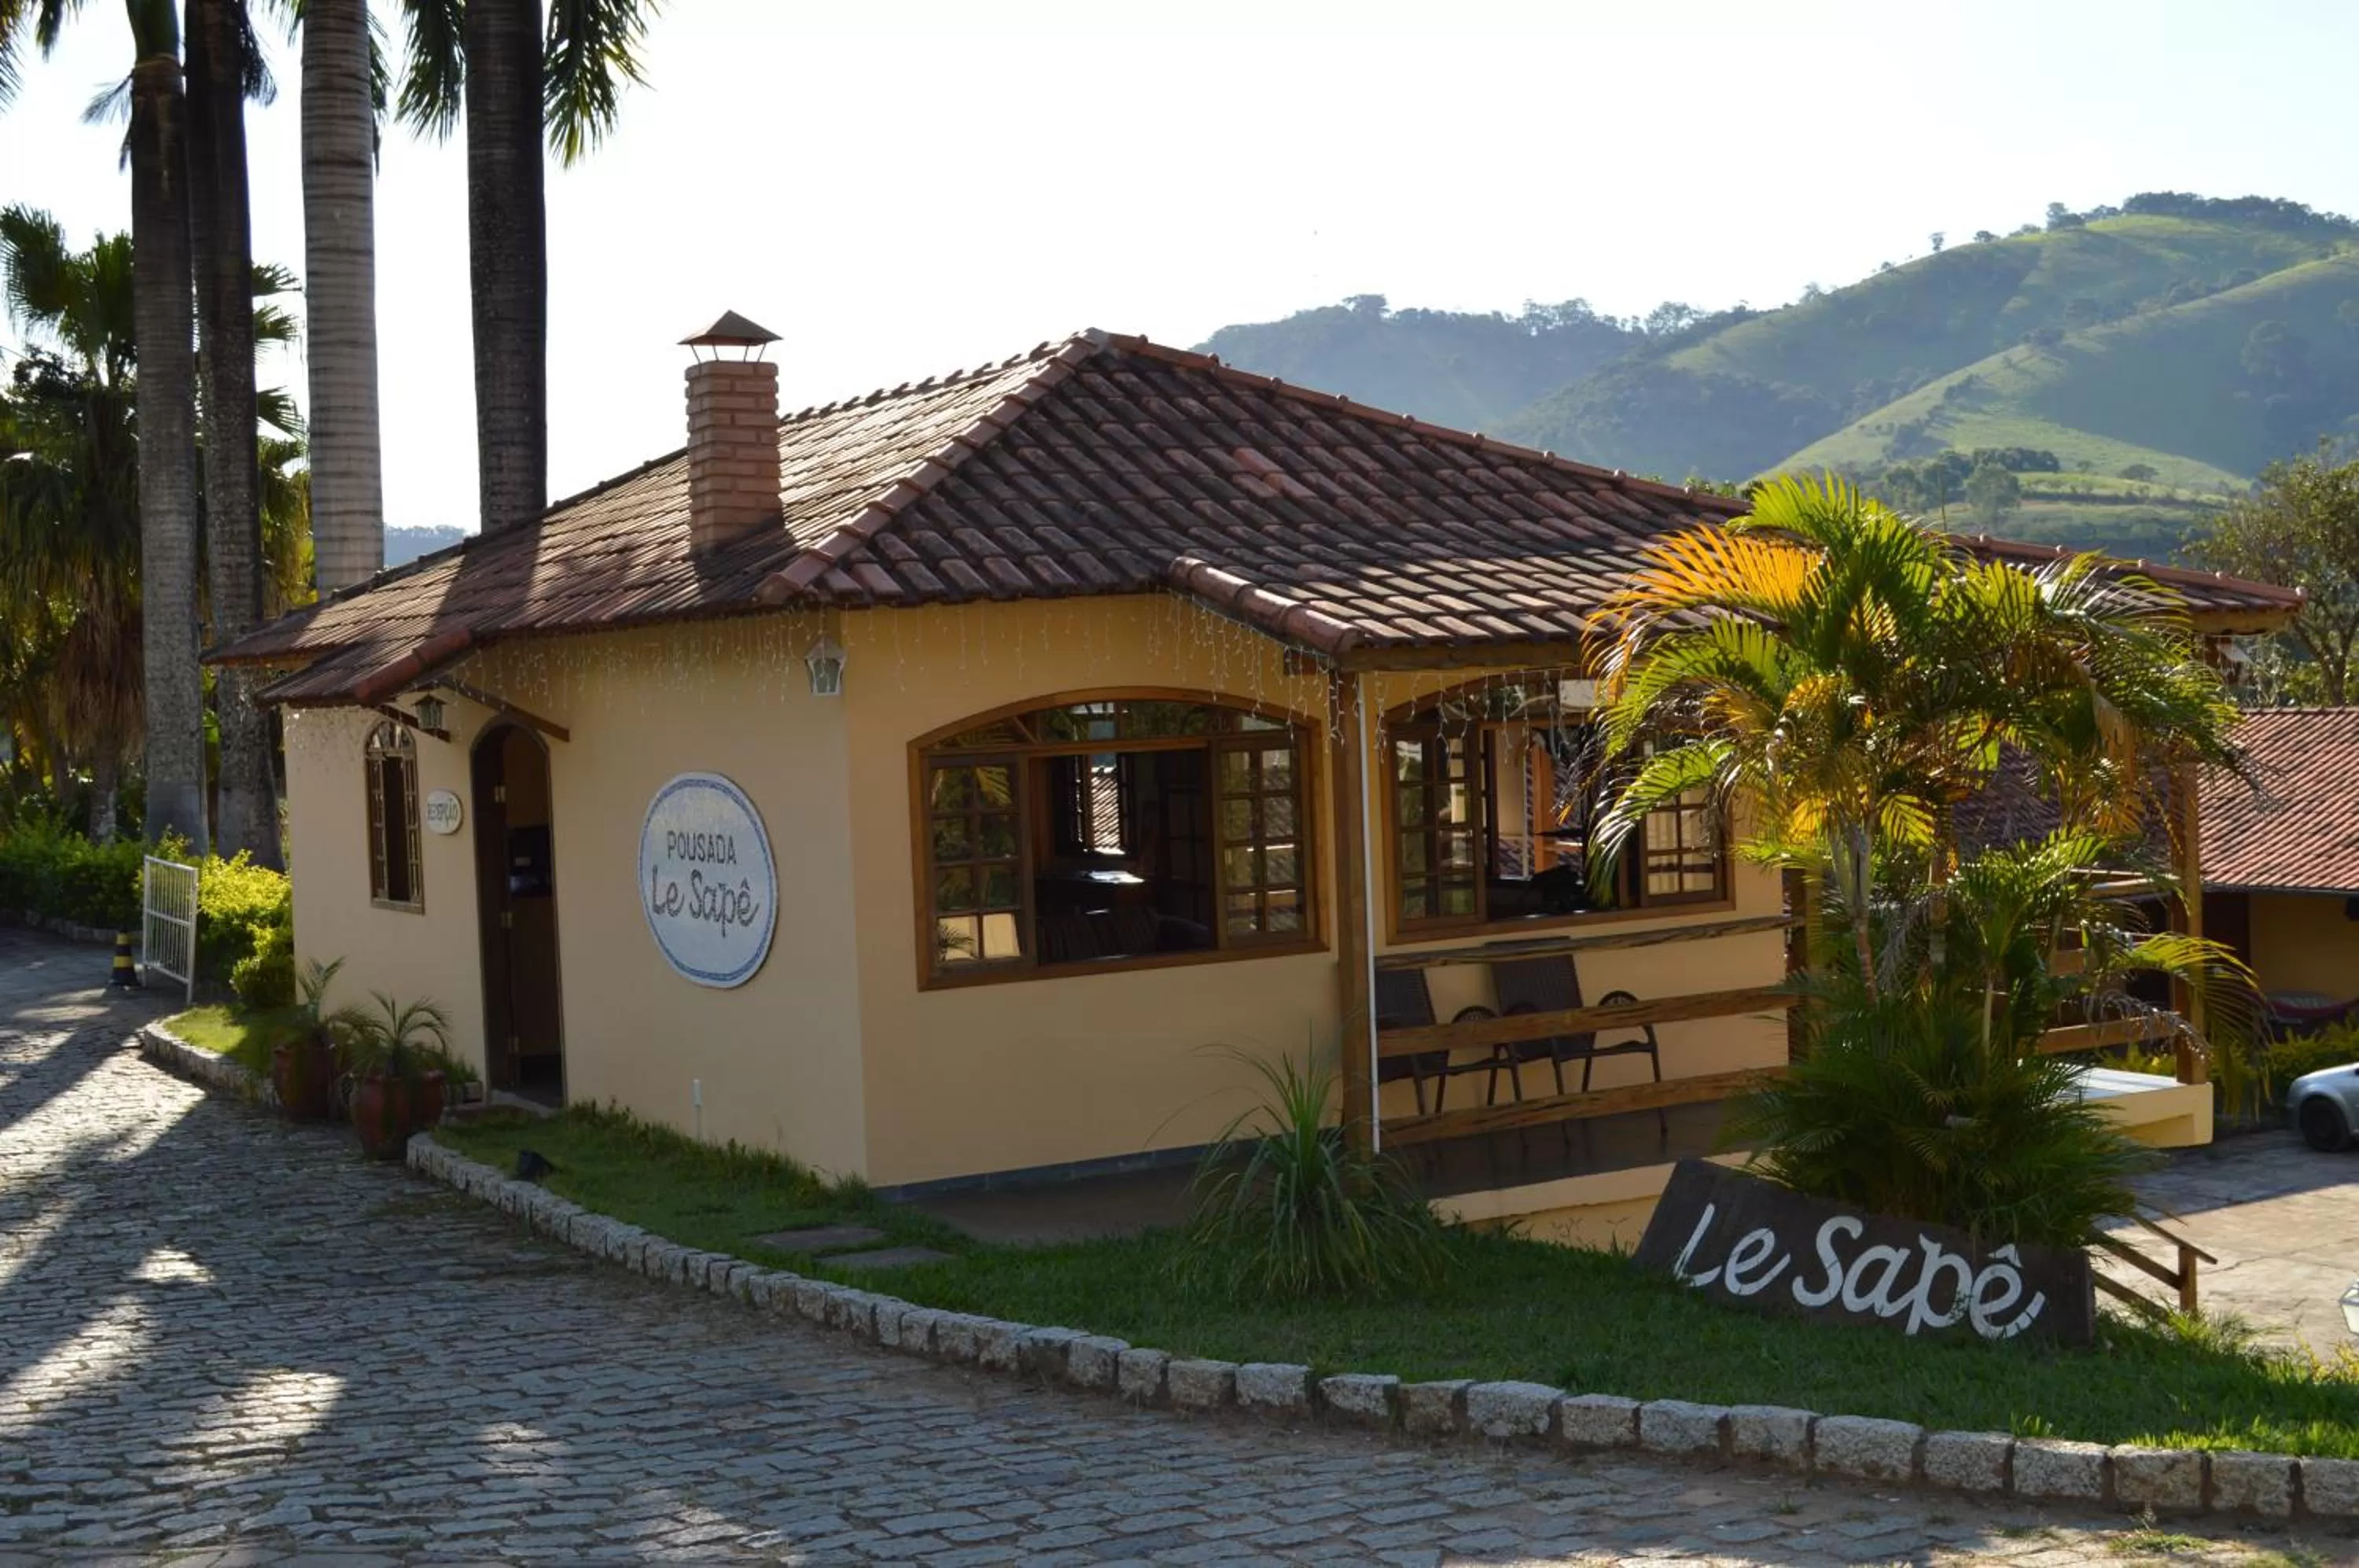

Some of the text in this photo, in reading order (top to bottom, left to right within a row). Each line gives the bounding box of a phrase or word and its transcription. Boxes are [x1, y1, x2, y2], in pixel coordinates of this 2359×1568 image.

[668, 830, 737, 864] POUSADA
[653, 865, 759, 938] Le Sapê
[1673, 1202, 2044, 1338] Le Sapê
